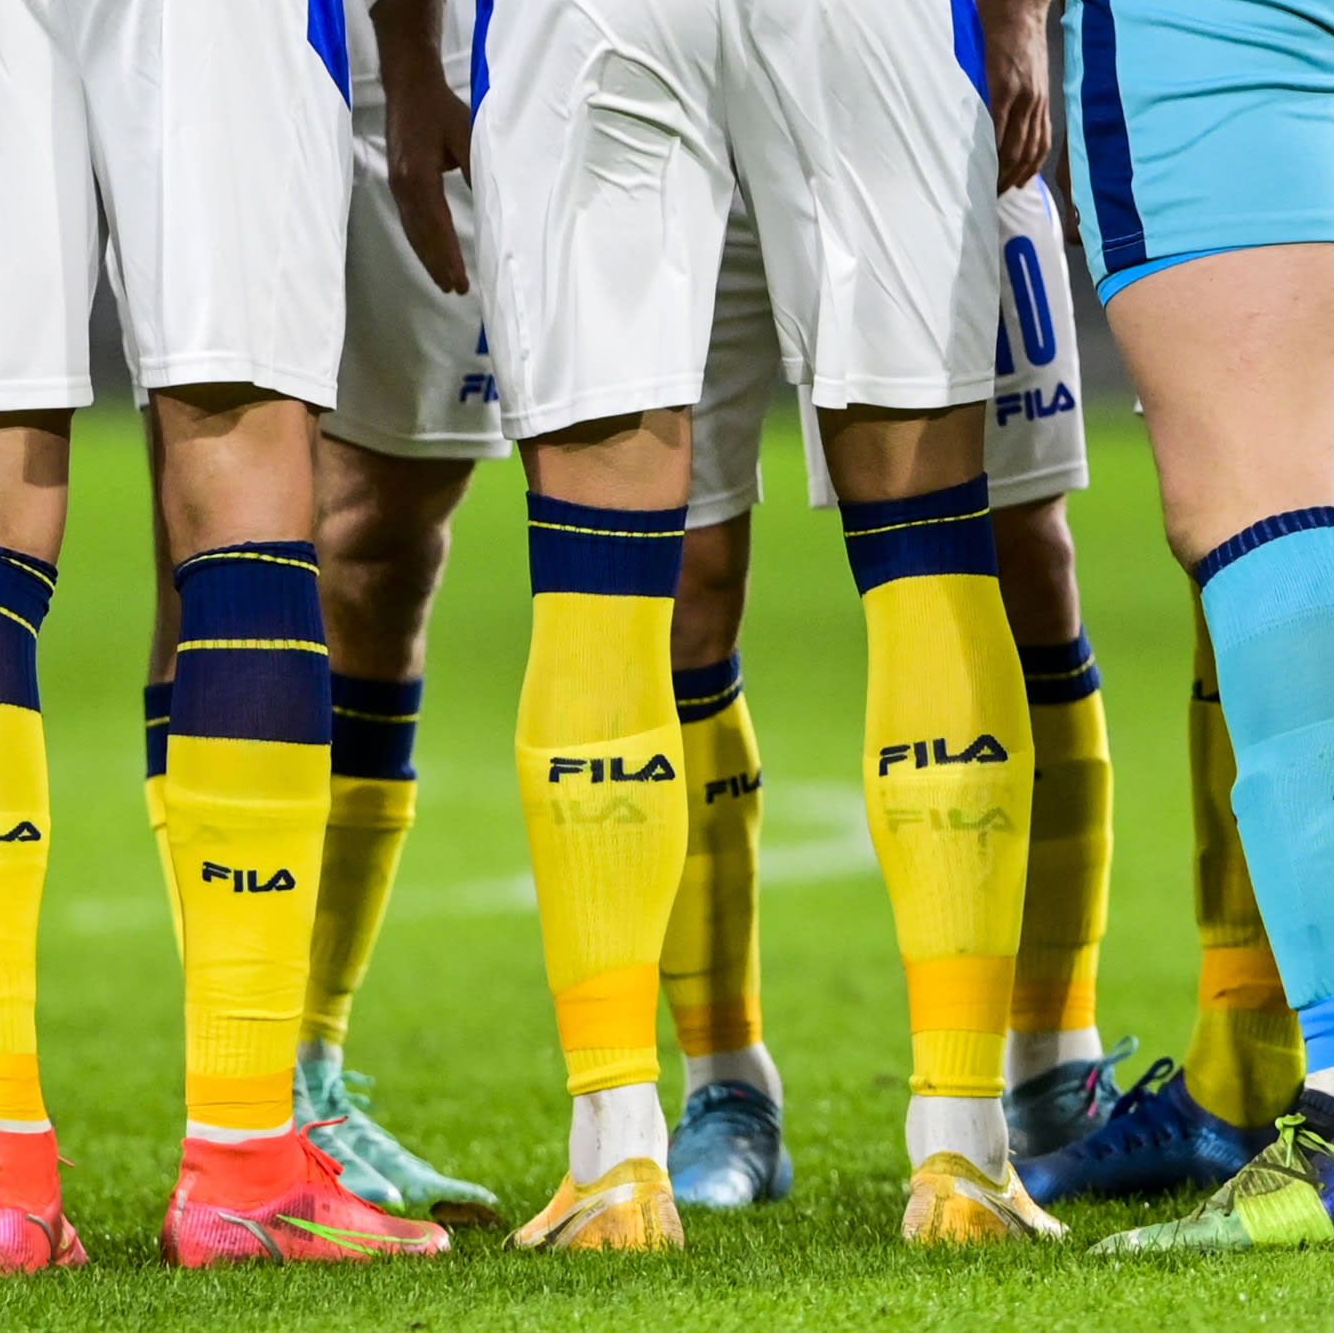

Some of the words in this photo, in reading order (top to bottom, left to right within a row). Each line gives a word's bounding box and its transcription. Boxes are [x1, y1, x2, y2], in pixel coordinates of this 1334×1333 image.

[995, 382, 1075, 426] FILA
[548, 753, 676, 784] FILA
[878, 734, 1008, 777] FILA
[202, 861, 297, 894] FILA
